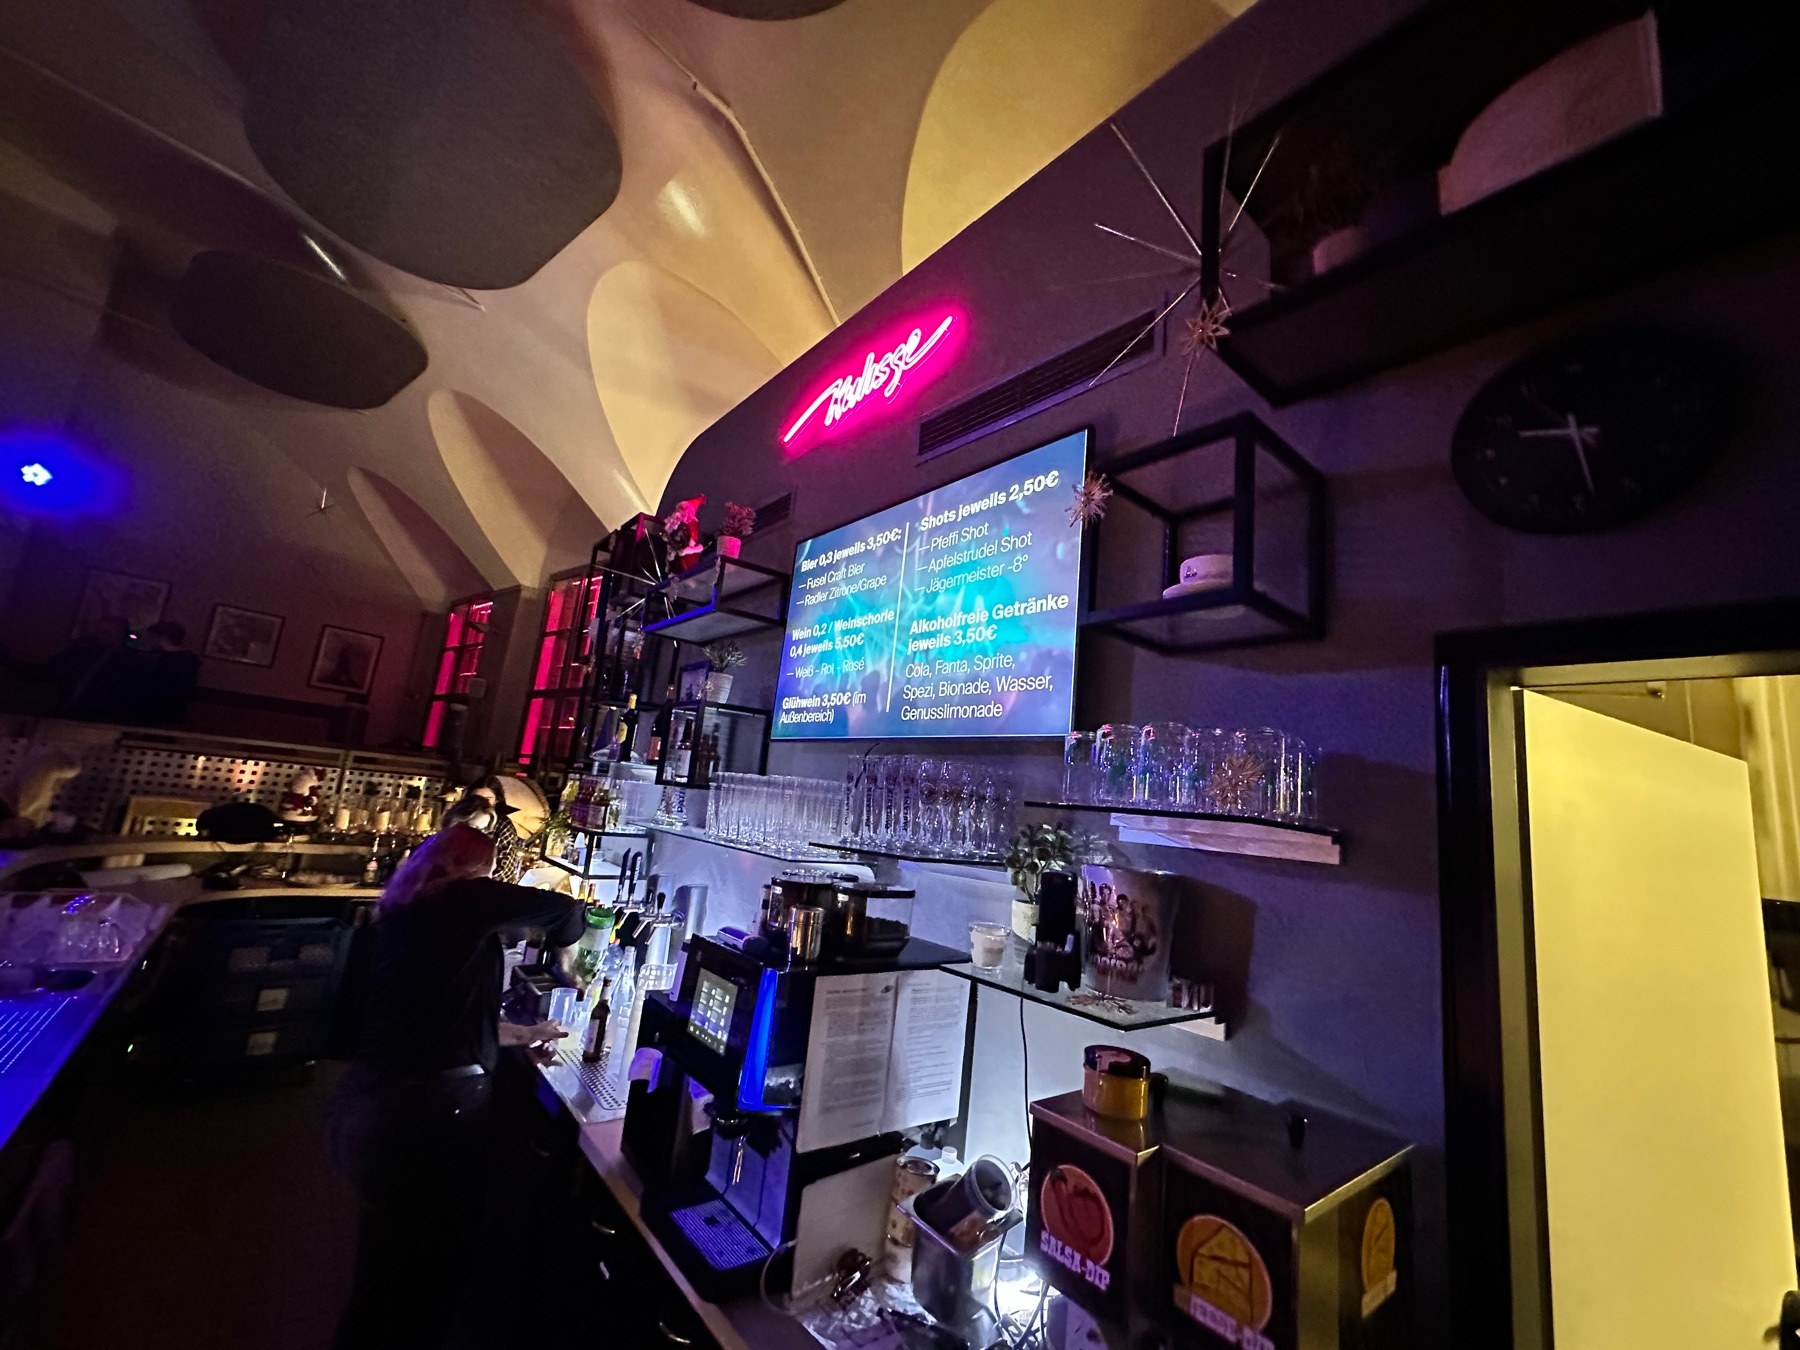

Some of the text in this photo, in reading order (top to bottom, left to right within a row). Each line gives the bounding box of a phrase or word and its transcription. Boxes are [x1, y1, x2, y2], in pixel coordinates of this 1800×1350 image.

[920, 470, 1060, 531] Shots jeweils 2,50€
[927, 539, 998, 574] Apfelstrudel
[1000, 530, 1034, 553] Shot
[930, 530, 960, 552] Pfeffi
[960, 521, 990, 543] Shot
[800, 558, 820, 573] Bier
[818, 550, 834, 567] 0,3
[832, 540, 866, 563] jeweils
[804, 591, 829, 607] Radler
[828, 574, 888, 600] Zitrone/Grape
[806, 573, 828, 590] Fusel
[827, 566, 848, 583] Craft
[847, 562, 866, 578] Bier
[926, 562, 1006, 594] Jägermeister
[791, 627, 813, 642] Wein
[812, 622, 828, 637] 0,2
[833, 608, 896, 632] Weinschorle
[909, 593, 1070, 636] Alkoholfreie Getränke
[789, 632, 865, 659] 0,4 jeweils 5,50€
[906, 624, 998, 656] jeweils 3,50€
[794, 664, 814, 679] Weiß
[842, 656, 865, 673] Rosé
[905, 652, 1016, 680] Cola, Fanta, Sprite,
[781, 690, 867, 710] Glühwein 3,50€ (im
[902, 674, 1054, 702] Spezi, Bionade, Wasser,
[779, 708, 835, 724] Außenbereich)
[900, 700, 1004, 721] Genusslimonade
[1040, 1230, 1111, 1292] SALSA-DIP
